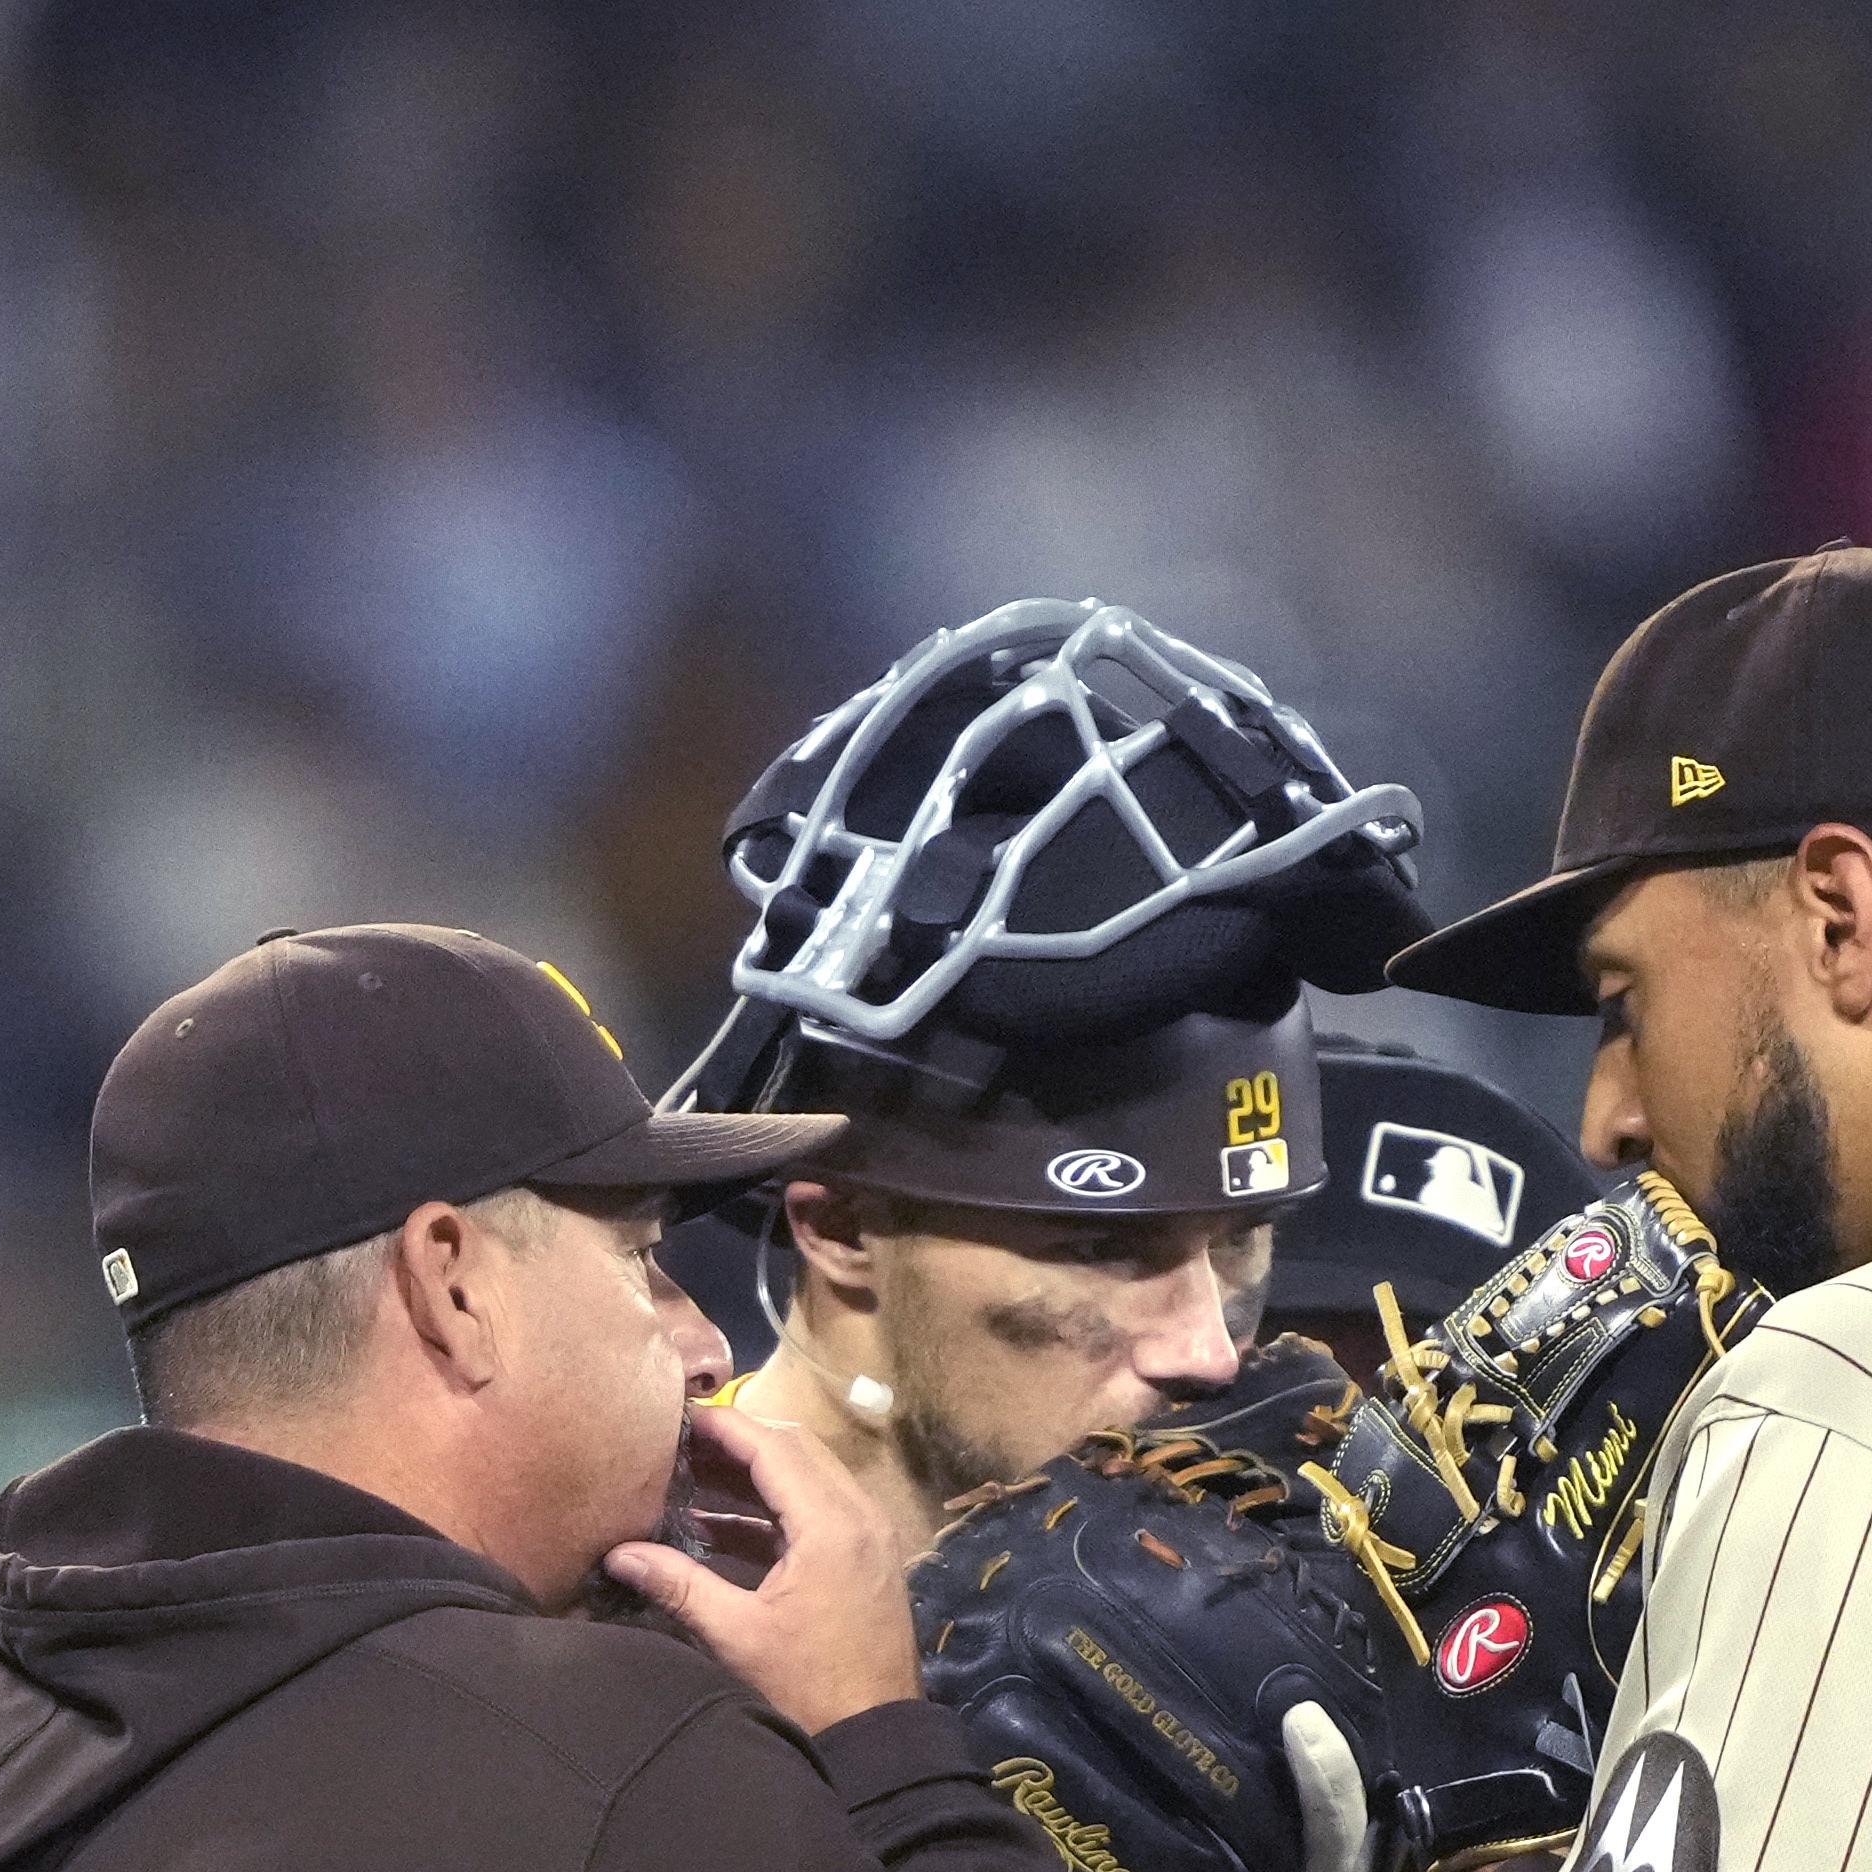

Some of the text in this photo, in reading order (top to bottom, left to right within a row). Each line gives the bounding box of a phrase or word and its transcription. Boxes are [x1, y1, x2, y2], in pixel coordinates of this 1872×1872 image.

[1226, 1070, 1281, 1146] 29
[1064, 1625, 1108, 1671] THE
[1102, 1660, 1156, 1714] GOLD
[1151, 1709, 1218, 1772] GLOVE
